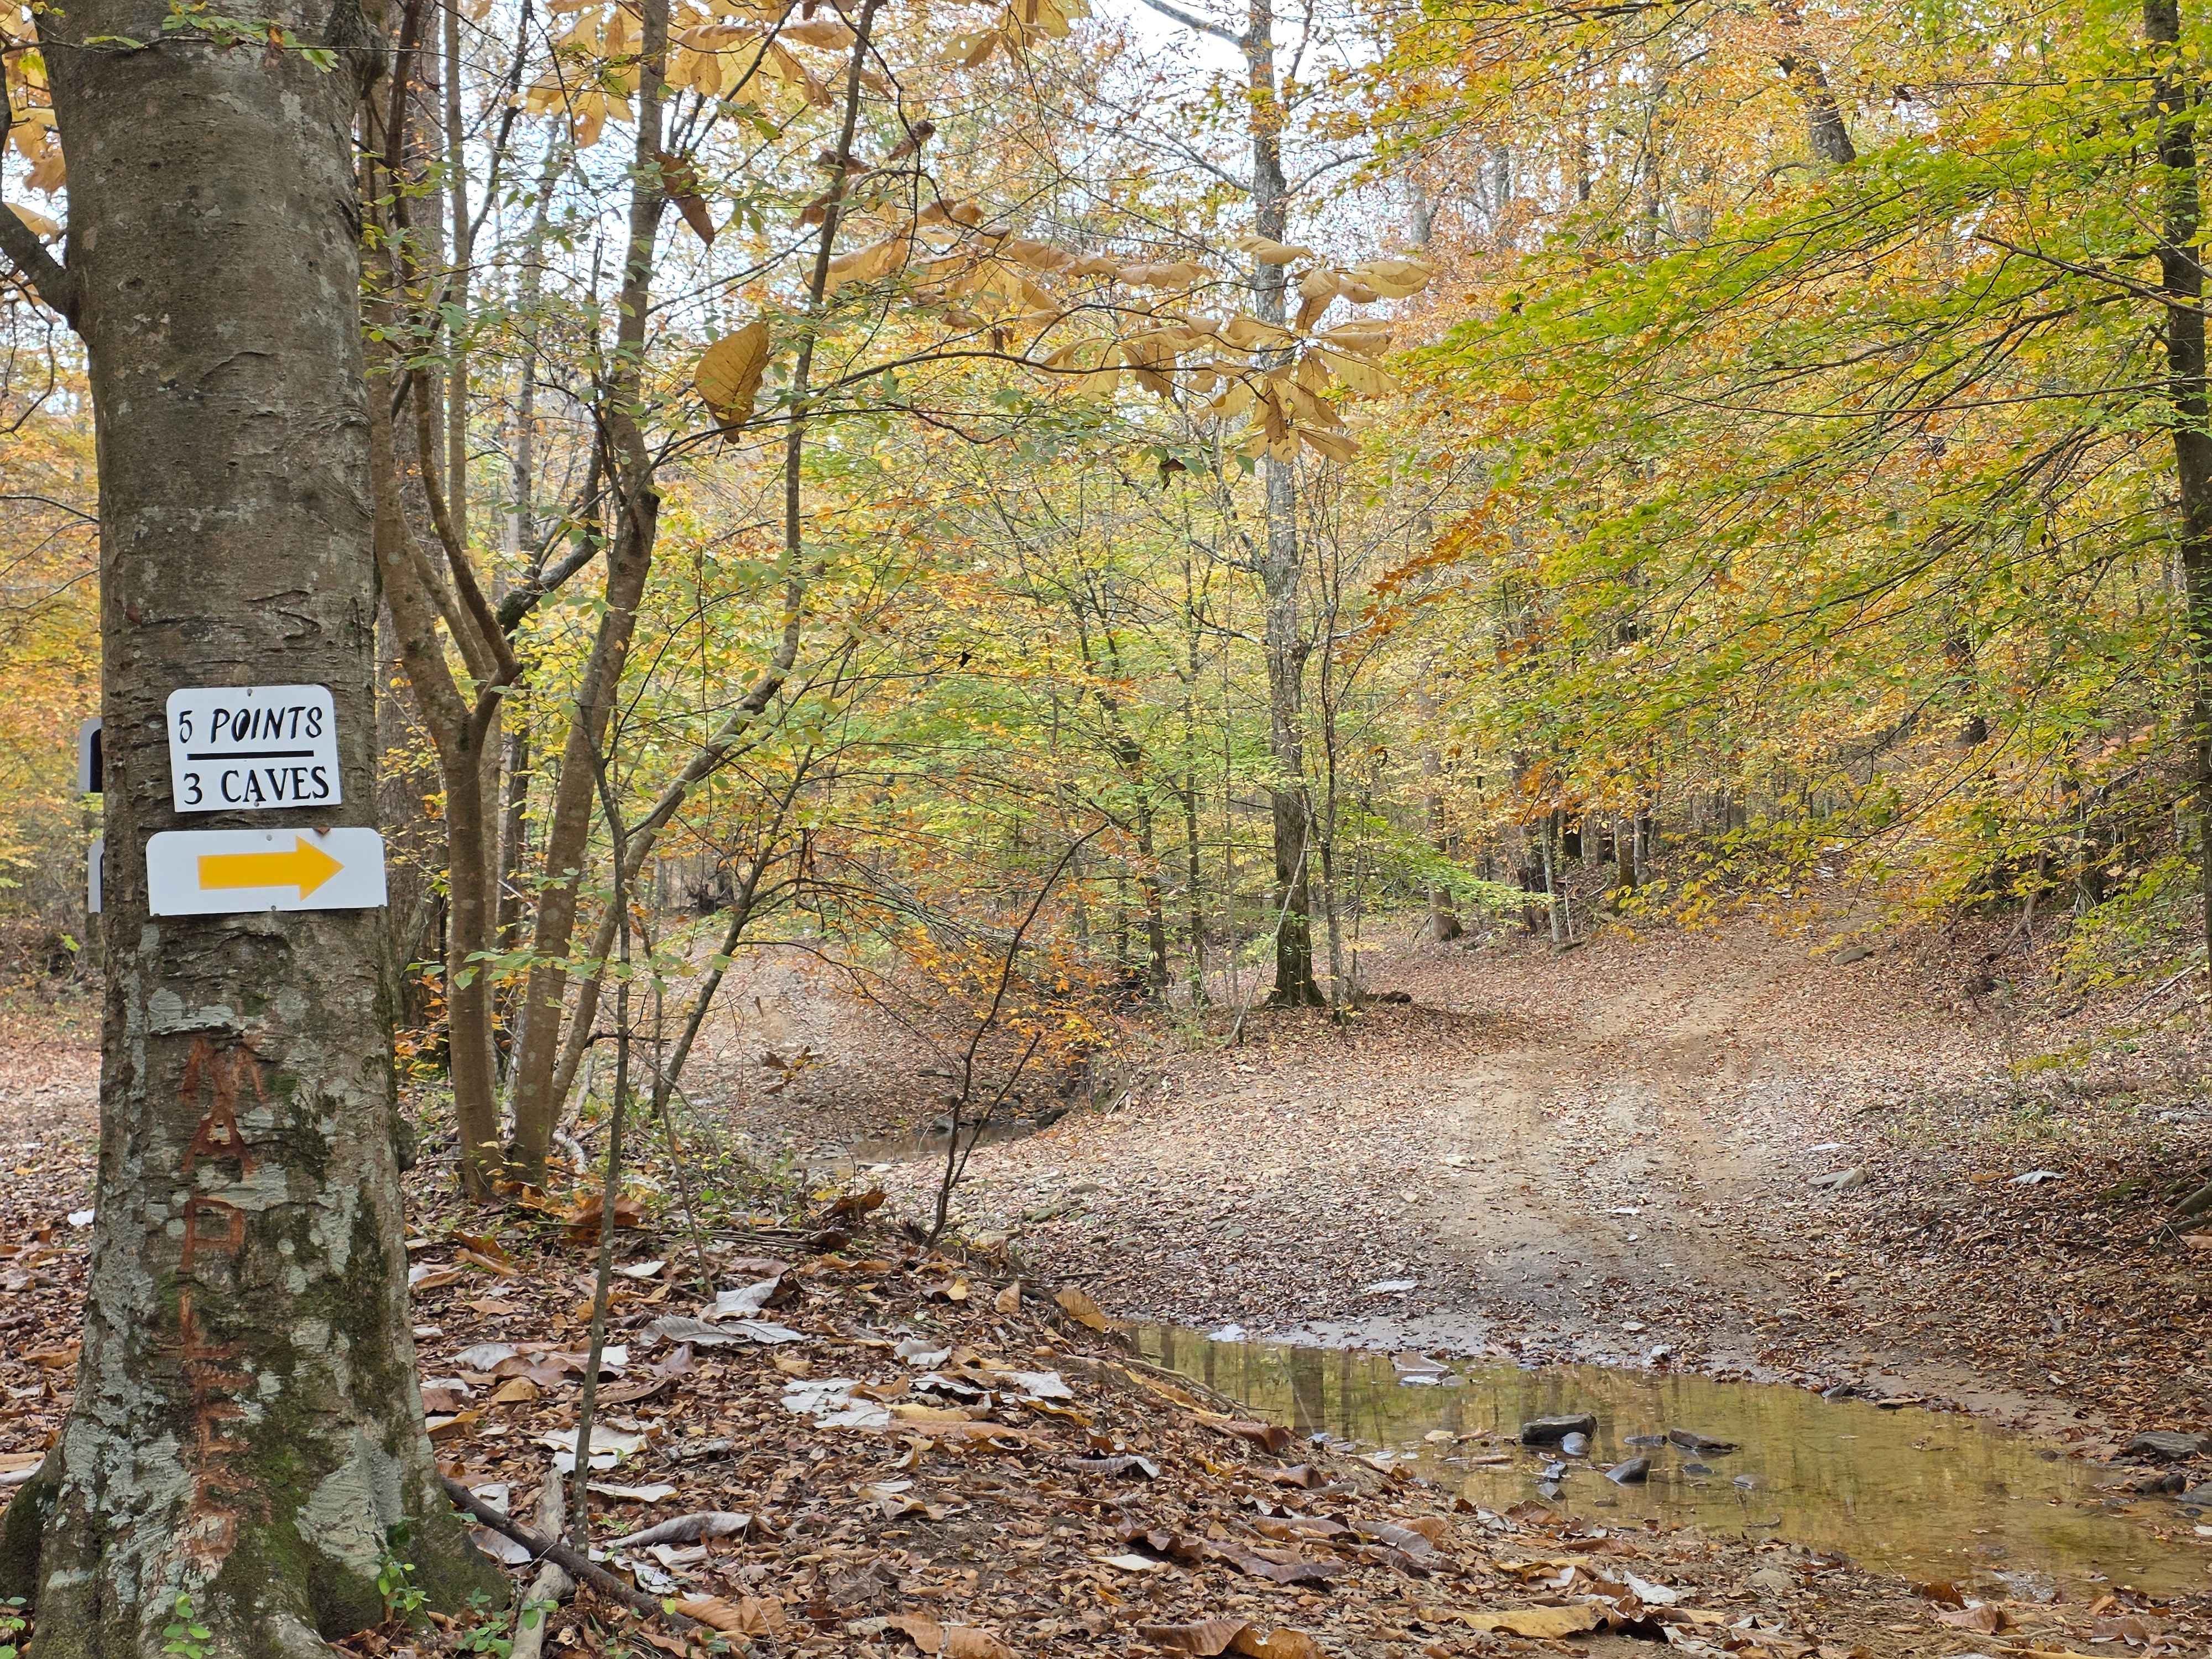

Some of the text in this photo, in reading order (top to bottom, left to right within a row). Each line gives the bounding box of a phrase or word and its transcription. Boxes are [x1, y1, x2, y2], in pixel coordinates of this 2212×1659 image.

[179, 706, 322, 744] 5 POINTS
[184, 766, 329, 805] 3 CAVES
